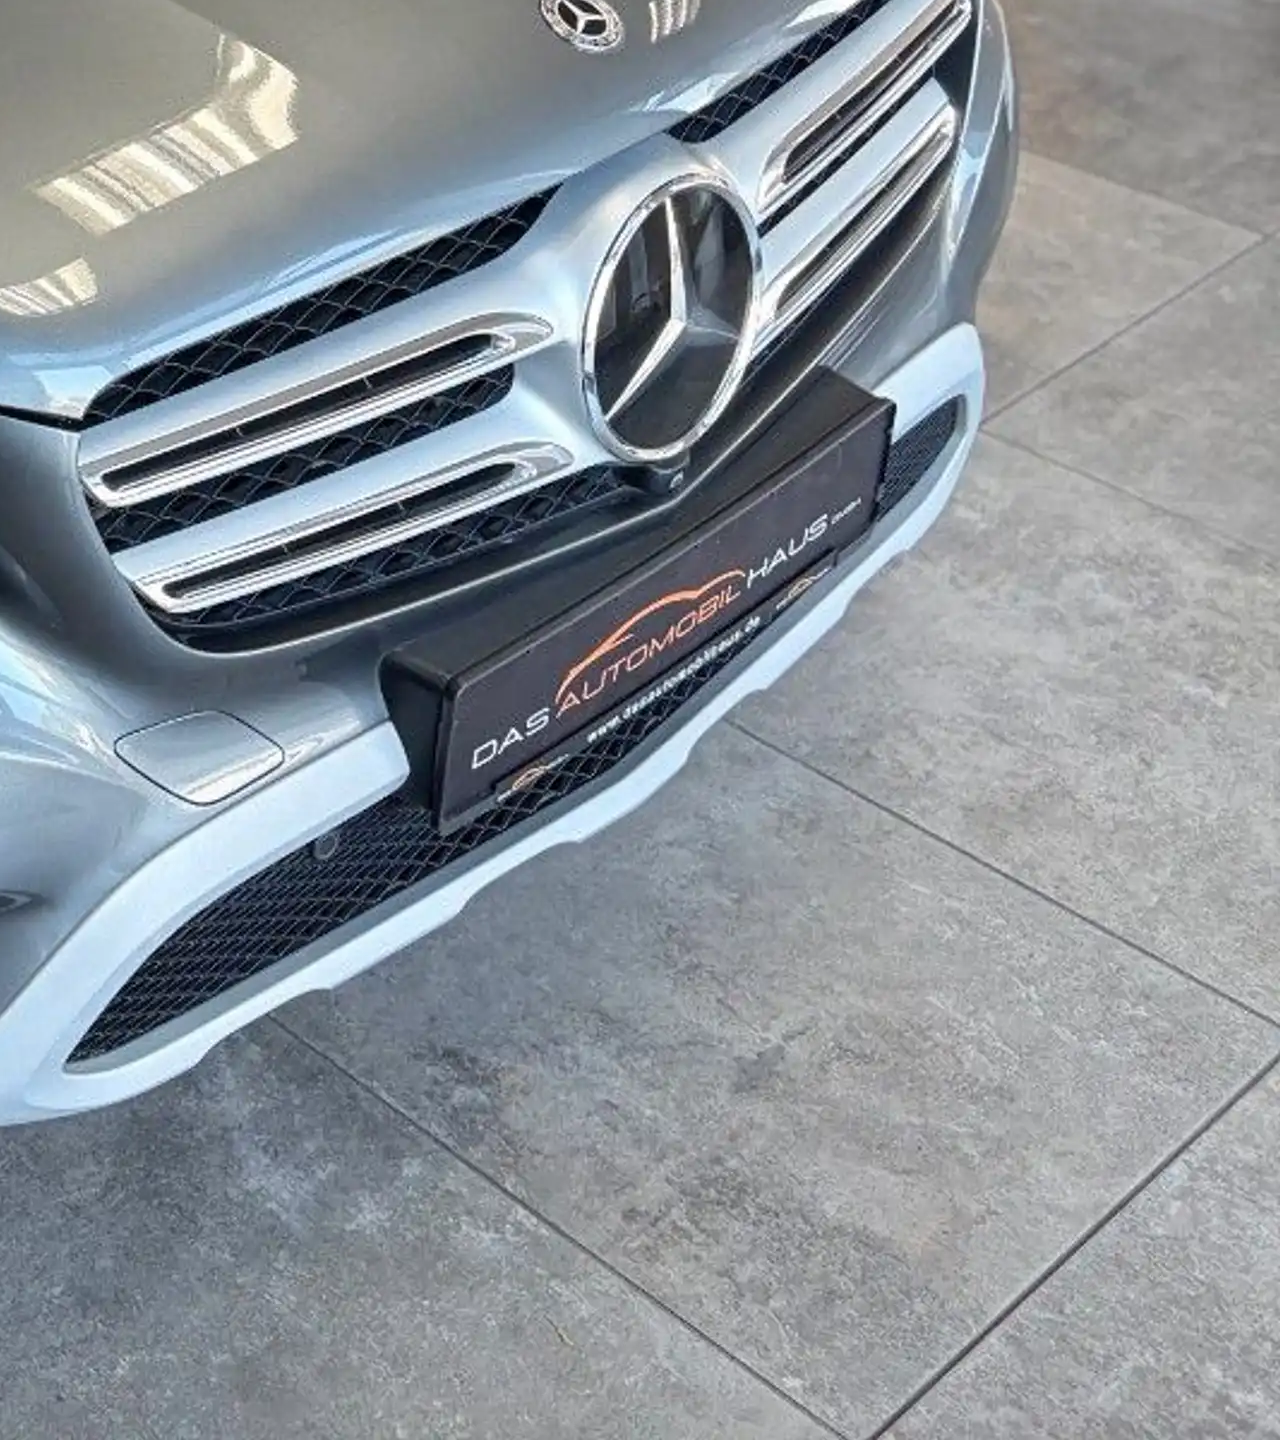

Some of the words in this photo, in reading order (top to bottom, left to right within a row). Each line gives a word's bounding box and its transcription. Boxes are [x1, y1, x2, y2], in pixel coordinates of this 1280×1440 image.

[471, 707, 551, 769] DAS
[556, 584, 741, 719] AUTOMOBIL
[746, 513, 828, 589] HAUS
